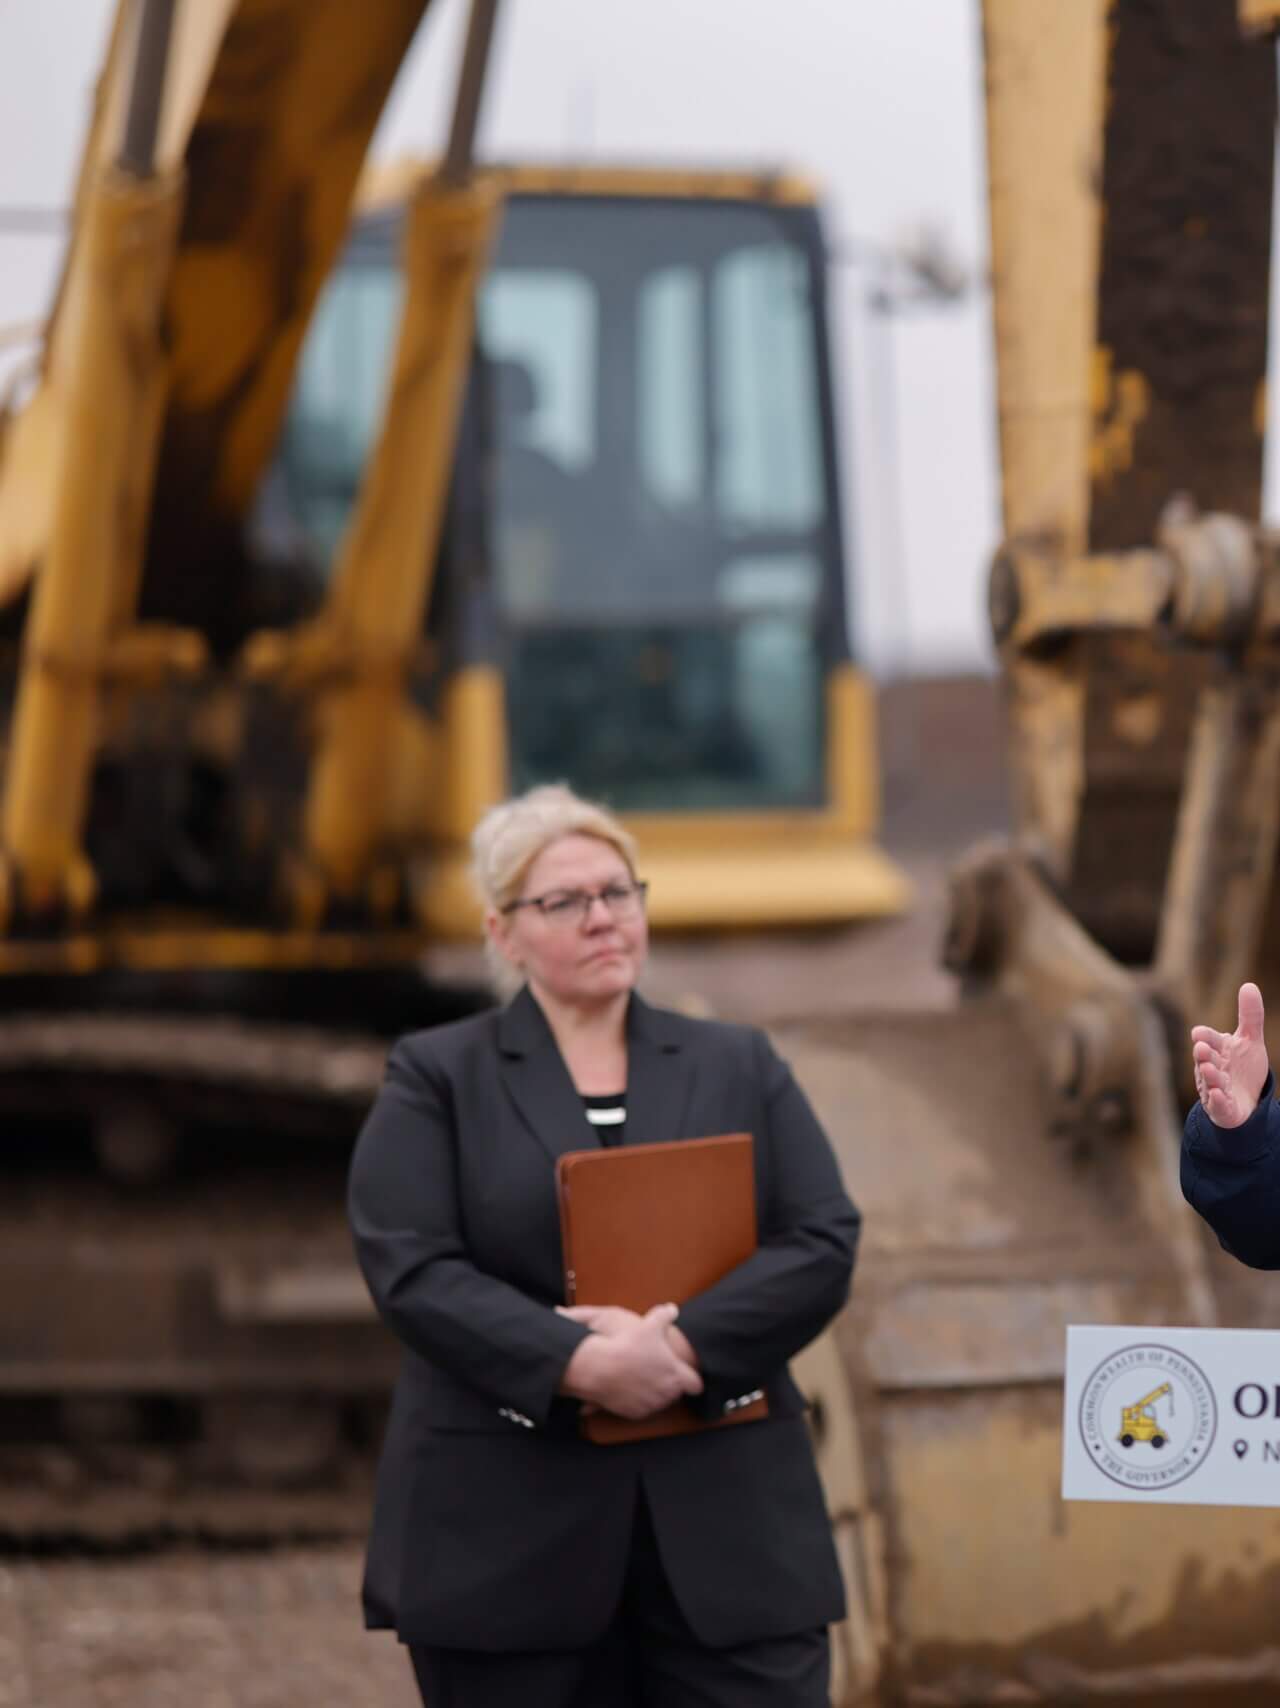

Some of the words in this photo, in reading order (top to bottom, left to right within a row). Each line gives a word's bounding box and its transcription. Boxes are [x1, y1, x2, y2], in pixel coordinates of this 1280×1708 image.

[1085, 1352, 1145, 1440] COMMONWEALTH
[1148, 1351, 1164, 1361] OF
[1101, 1454, 1123, 1474] THE
[1125, 1456, 1191, 1483] GOVERNOR
